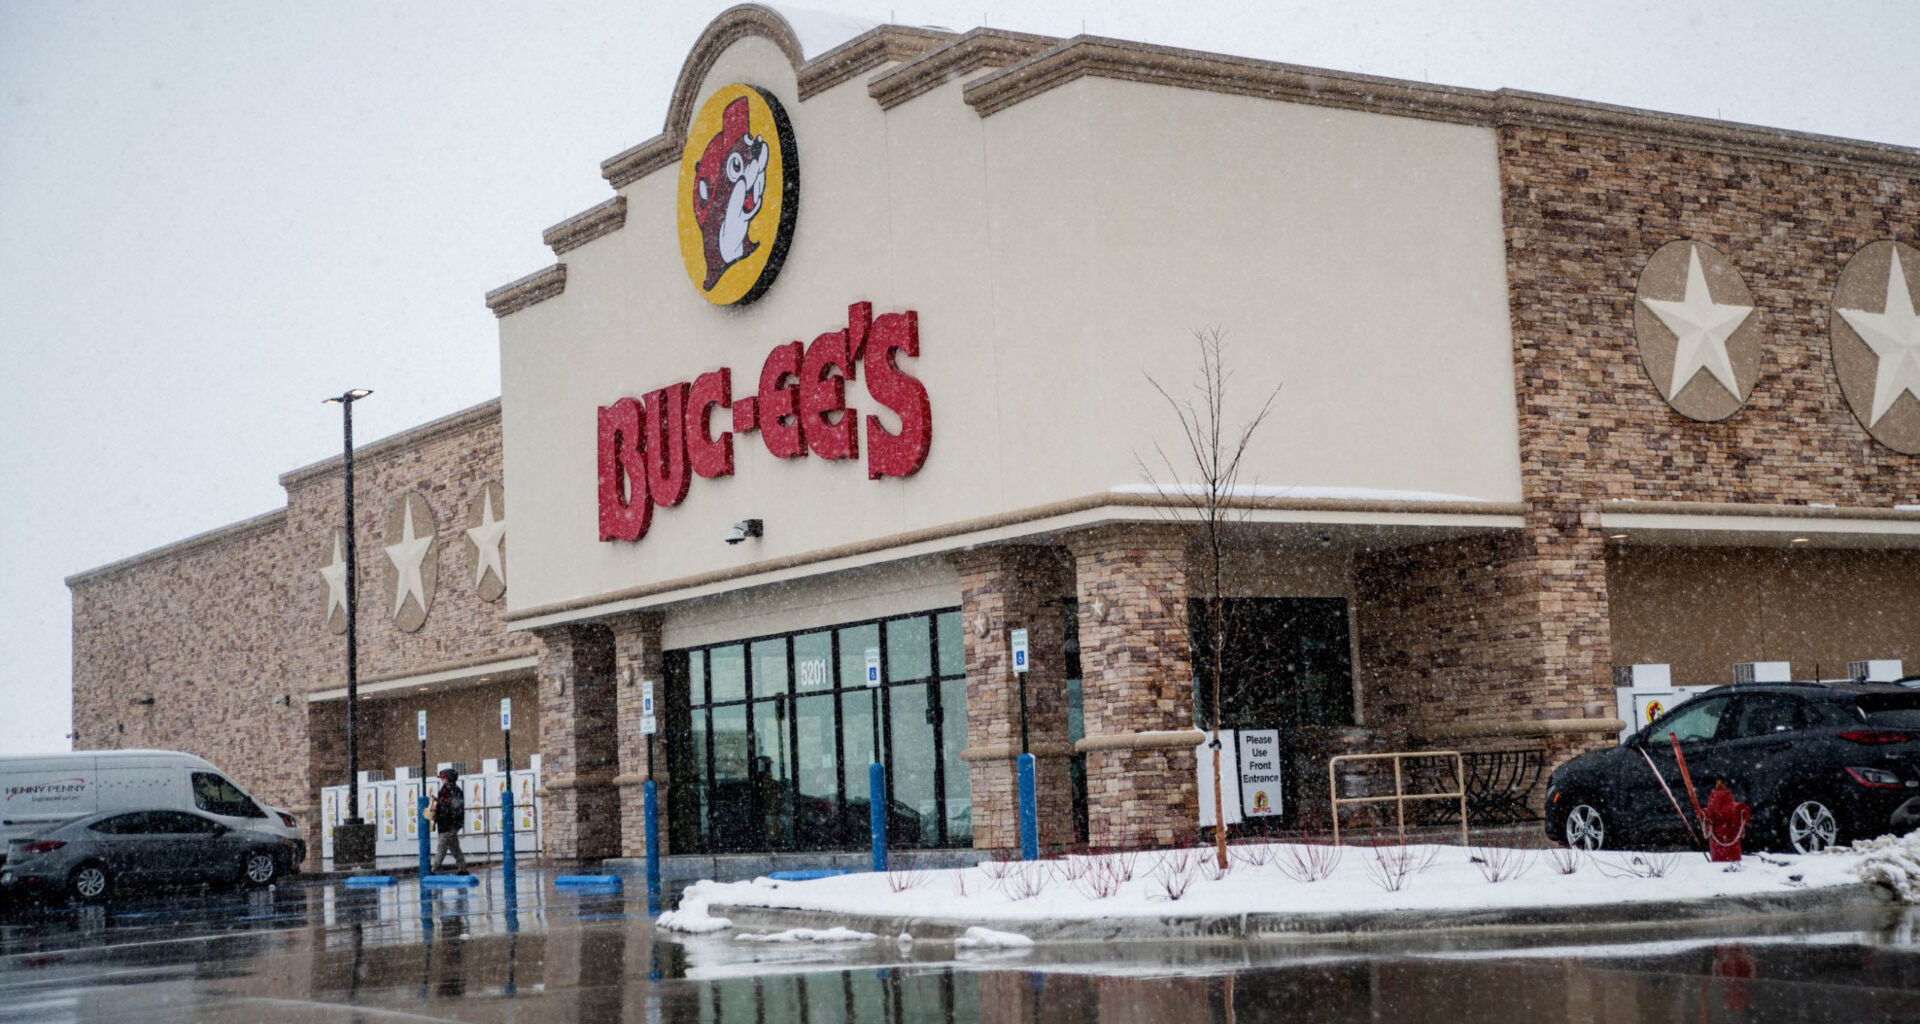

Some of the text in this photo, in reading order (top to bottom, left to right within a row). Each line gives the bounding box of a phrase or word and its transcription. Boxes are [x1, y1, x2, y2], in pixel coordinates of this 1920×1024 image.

[597, 301, 933, 542] BUC-EE'S
[801, 659, 826, 686] 5201
[1246, 735, 1272, 744] Please
[1252, 748, 1267, 757] Use
[1249, 761, 1271, 770] Front
[1243, 774, 1279, 784] Entrance
[6, 784, 86, 794] HENNY PENNY
